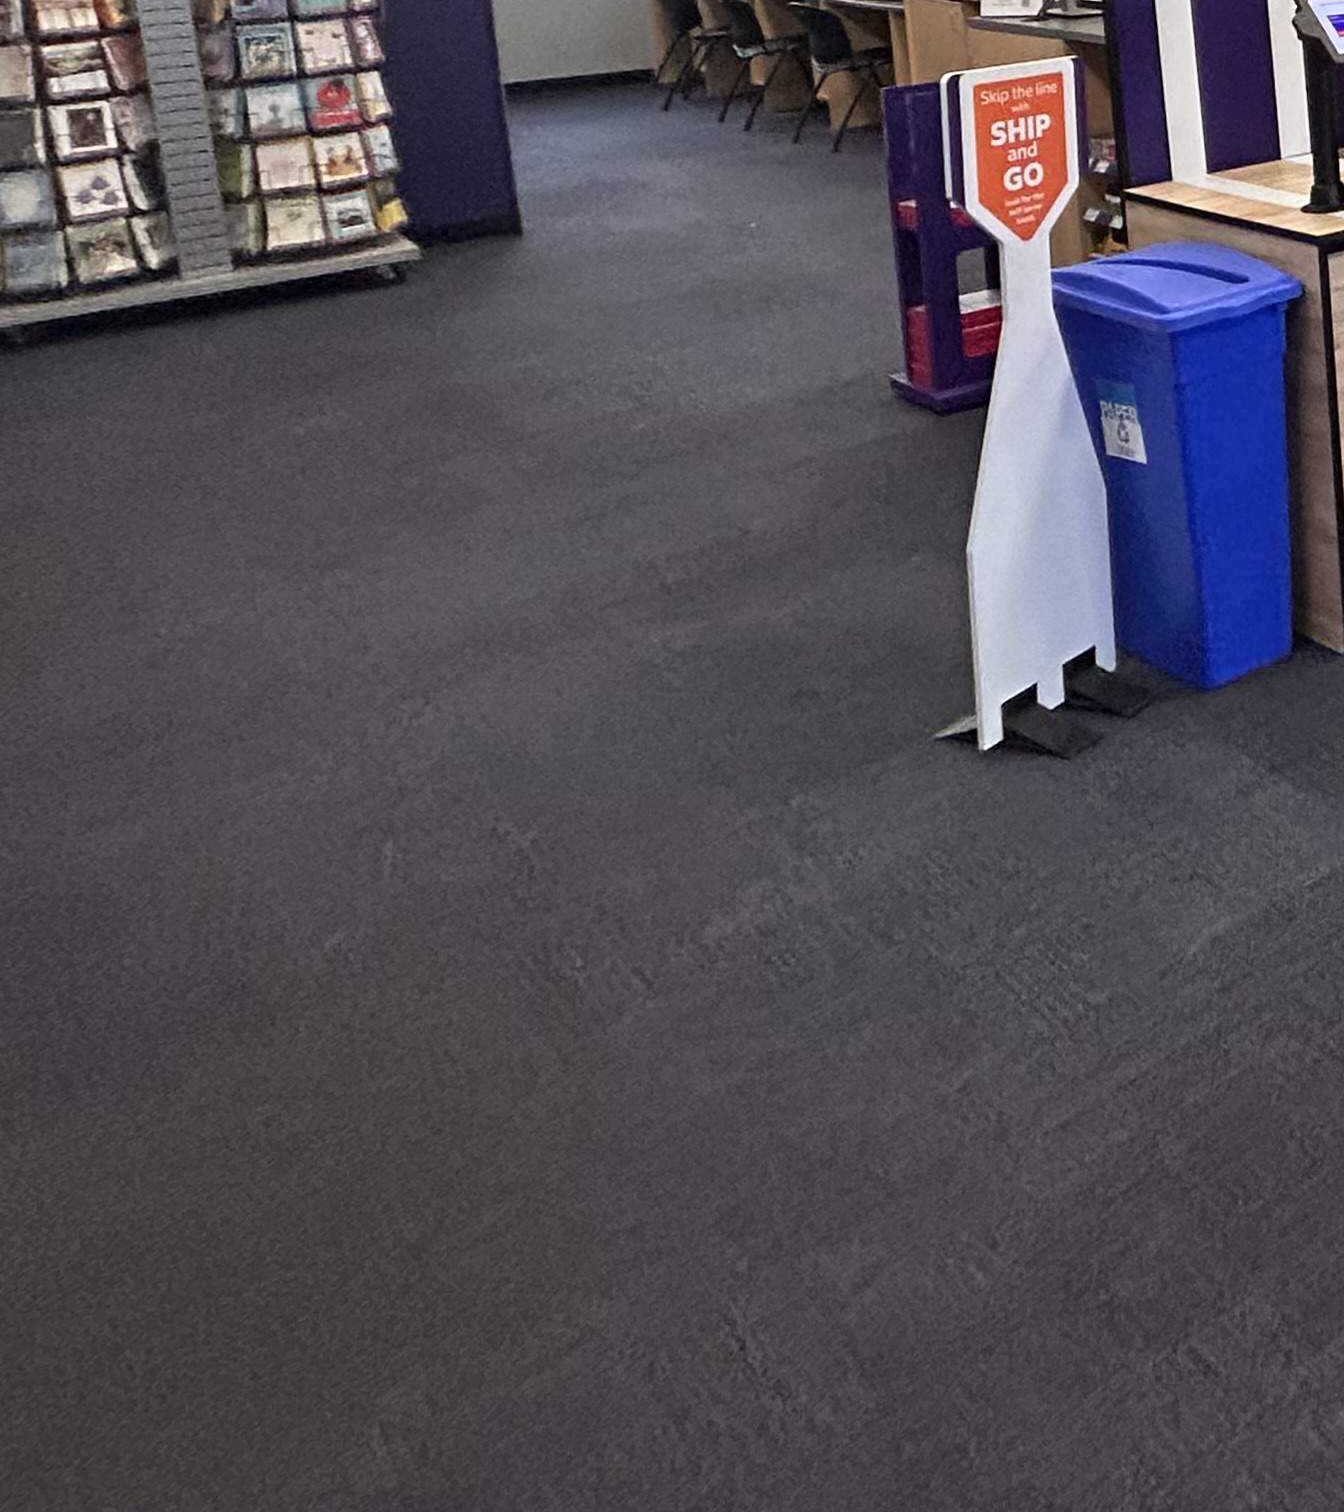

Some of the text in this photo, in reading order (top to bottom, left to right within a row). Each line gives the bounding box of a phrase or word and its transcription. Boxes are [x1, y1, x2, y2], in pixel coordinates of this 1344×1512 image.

[980, 81, 1058, 106] Skip the line
[990, 113, 1051, 147] SHIP
[1007, 141, 1038, 162] and
[1003, 162, 1044, 191] GO
